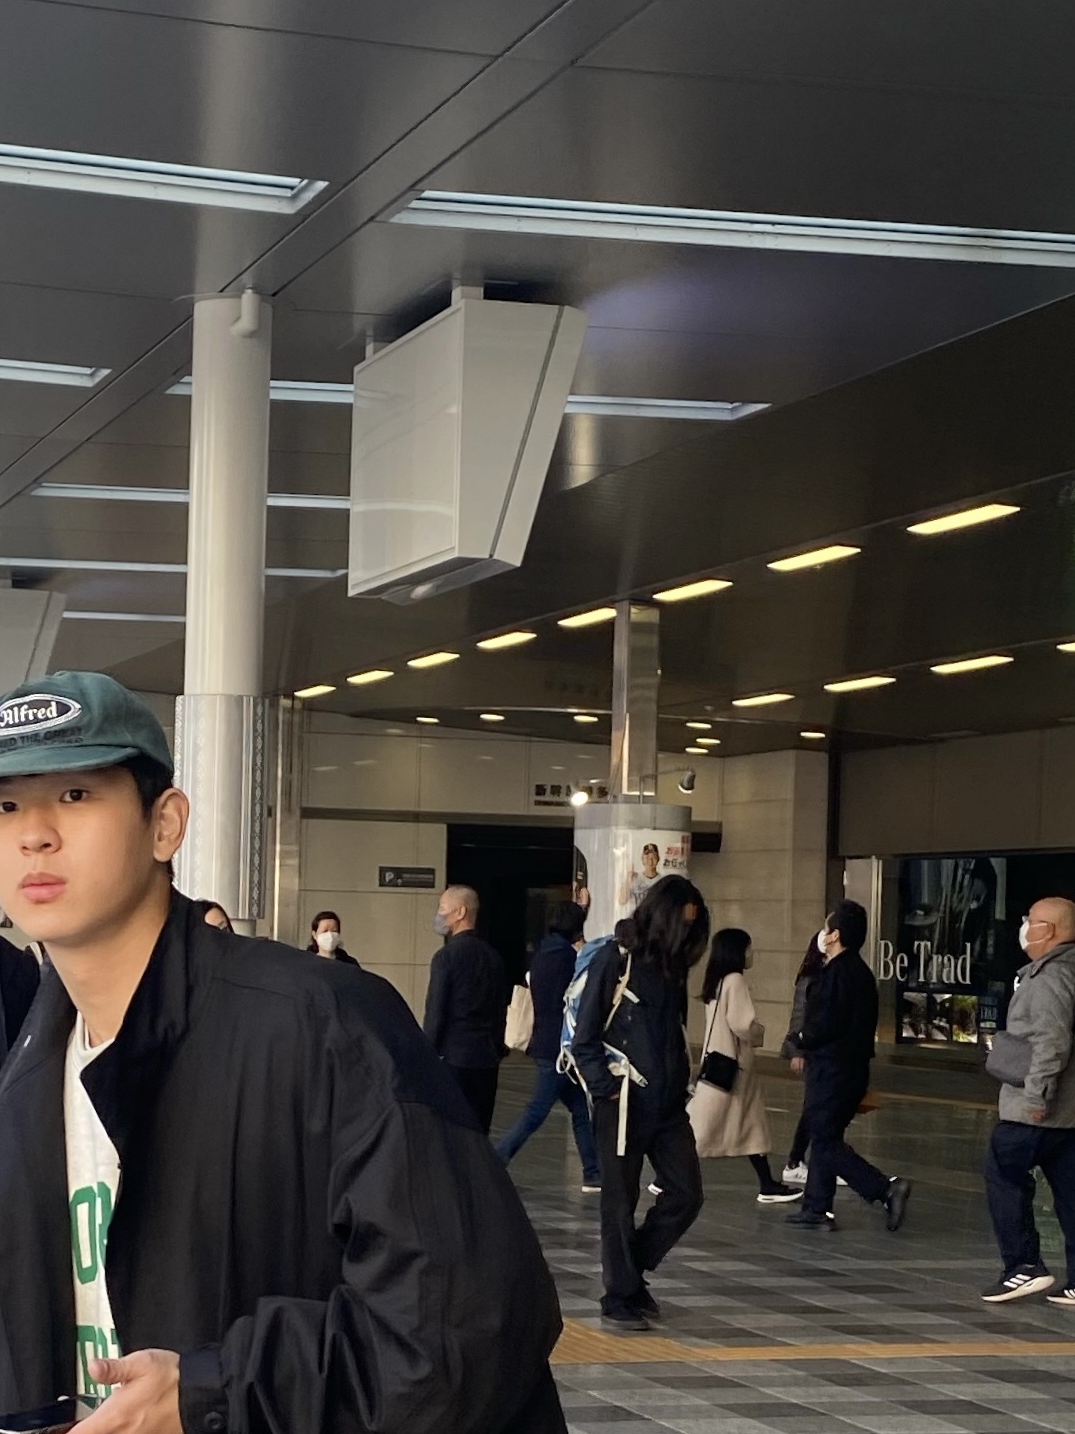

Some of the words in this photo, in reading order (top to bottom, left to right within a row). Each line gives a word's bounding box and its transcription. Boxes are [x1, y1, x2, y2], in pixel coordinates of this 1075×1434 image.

[385, 871, 394, 883] P
[878, 939, 909, 982] Be
[913, 941, 972, 985] Trad
